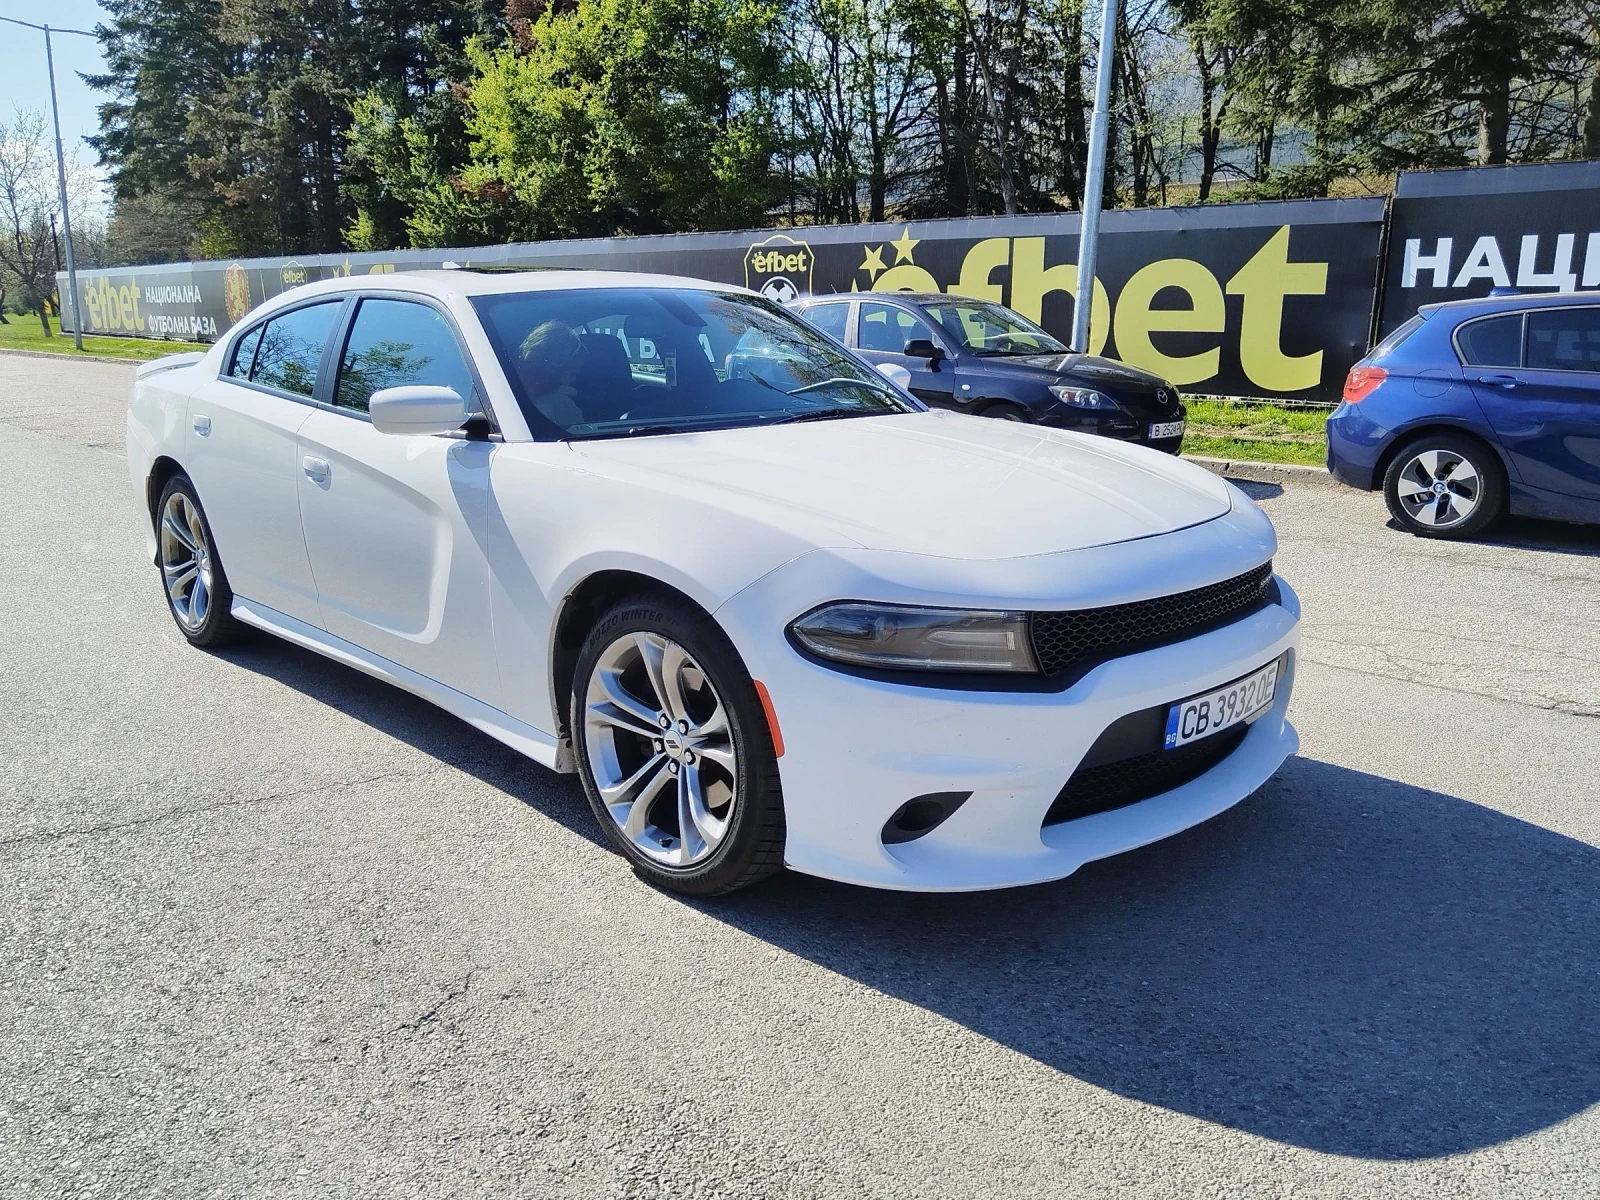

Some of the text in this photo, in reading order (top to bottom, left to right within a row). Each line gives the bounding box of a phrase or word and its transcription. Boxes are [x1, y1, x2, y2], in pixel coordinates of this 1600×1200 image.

[754, 250, 807, 273] efbet
[284, 269, 305, 284] efbet
[88, 275, 145, 332] efbet
[145, 285, 202, 306] НАЦИОНАЛНА
[148, 314, 218, 335] ФУТБОЛНА БАЗА
[589, 615, 618, 649] MOZZO
[621, 609, 663, 623] WINTER
[1181, 701, 1210, 739] CB
[1213, 681, 1256, 728] 3932
[1165, 732, 1177, 744] BG
